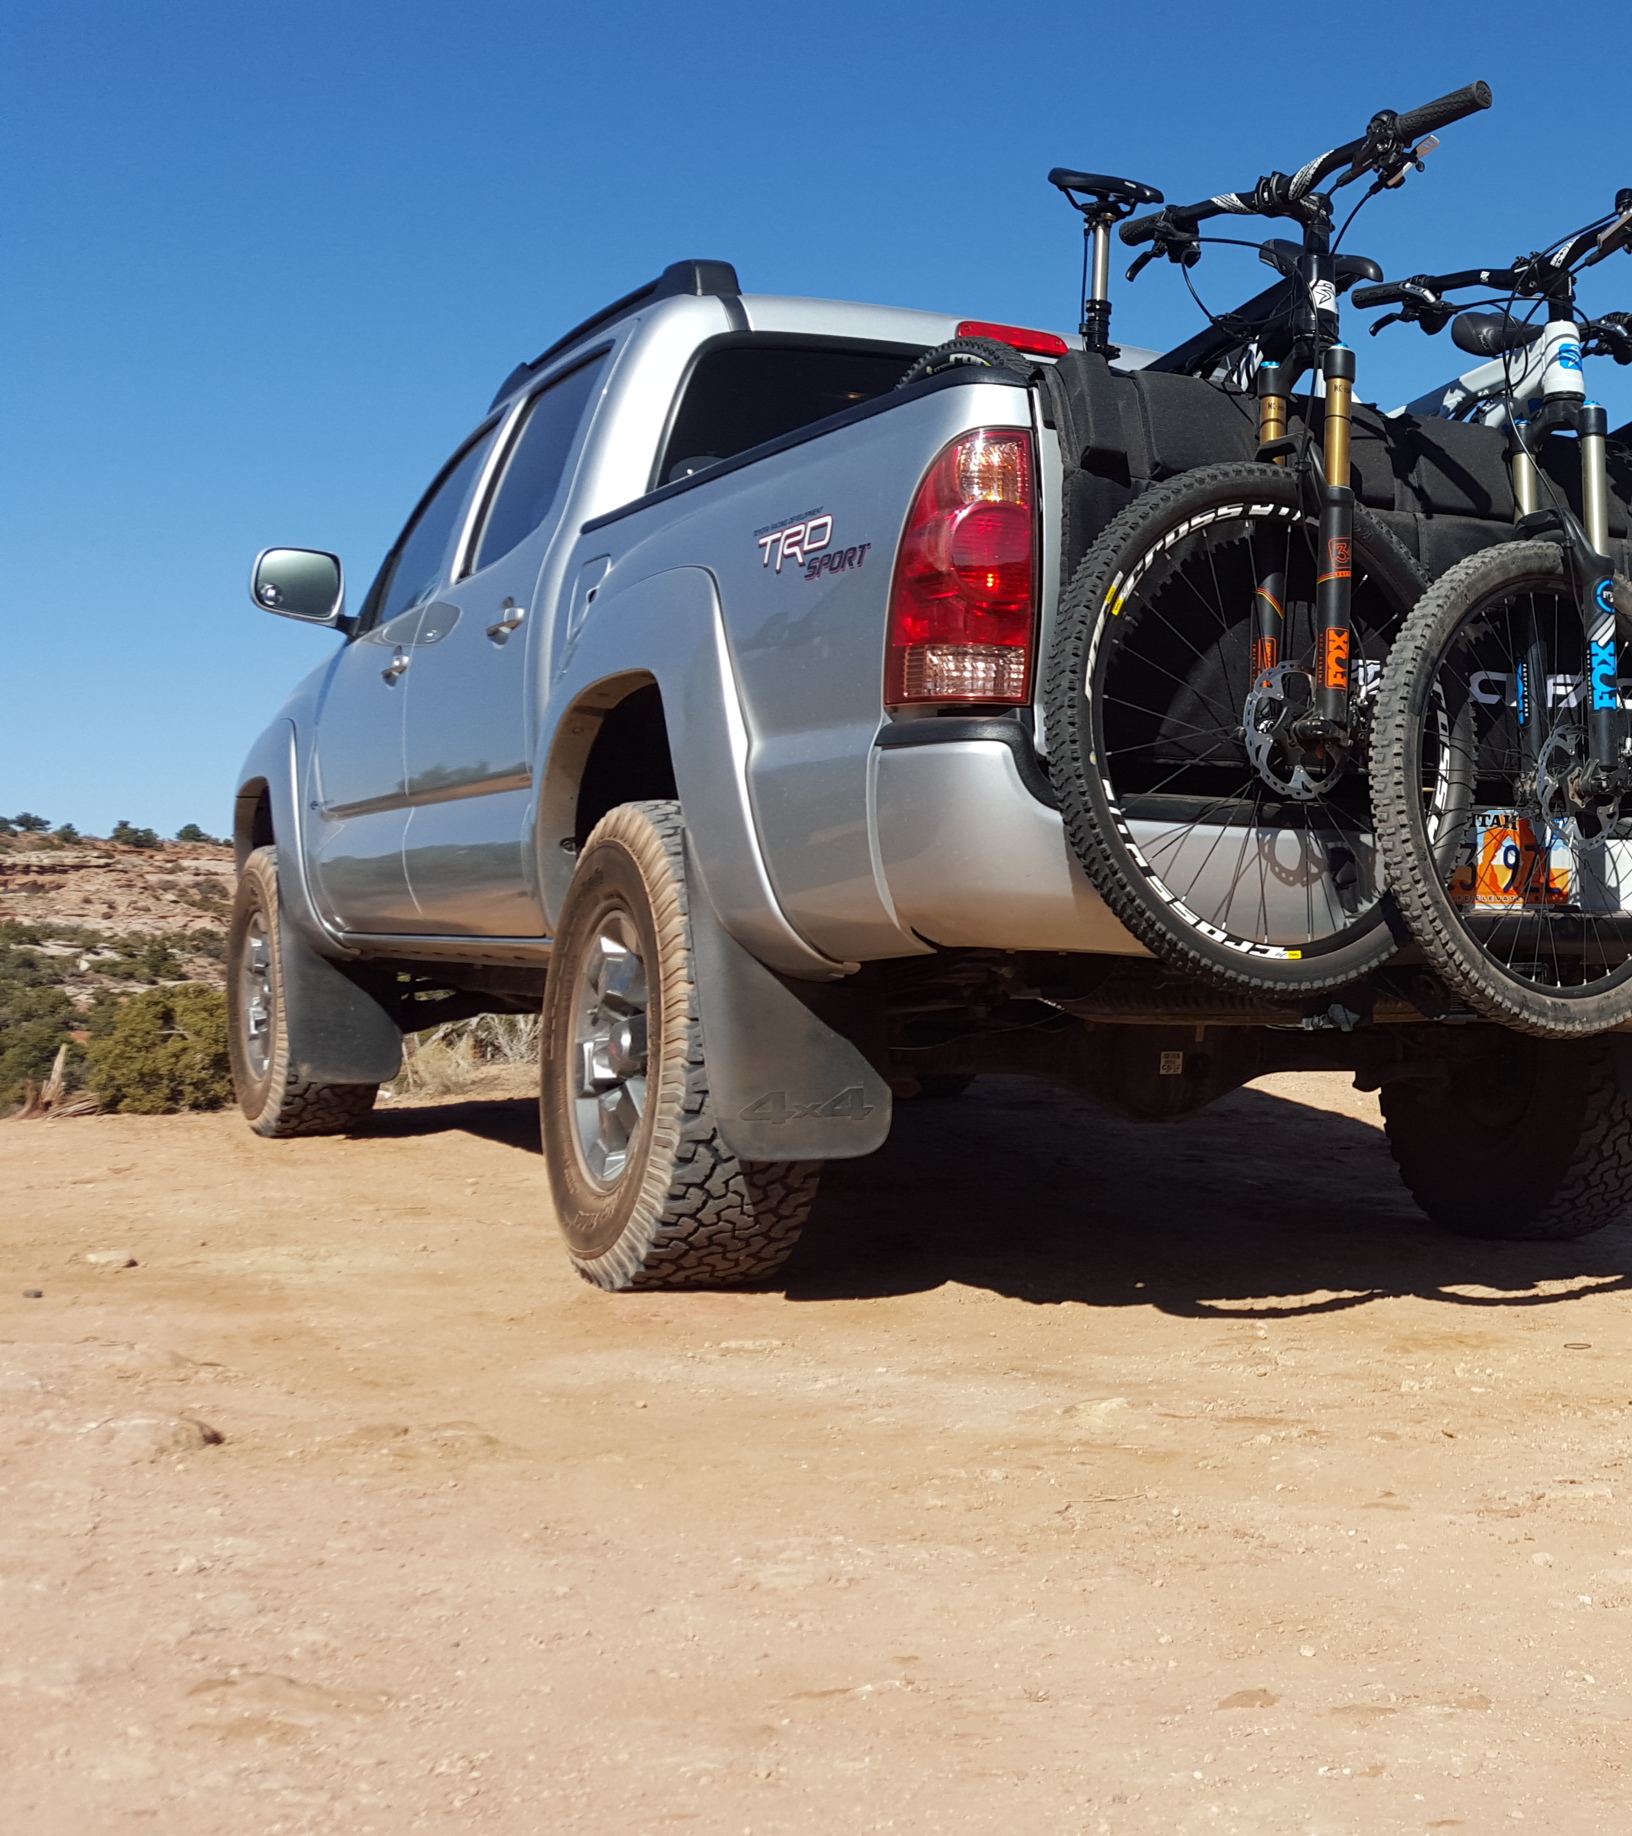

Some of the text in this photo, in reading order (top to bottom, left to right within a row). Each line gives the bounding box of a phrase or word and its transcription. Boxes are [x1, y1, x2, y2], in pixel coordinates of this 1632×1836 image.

[759, 513, 835, 574] TRD
[804, 543, 872, 580] SPORT
[1327, 629, 1349, 688] FOX
[1590, 641, 1617, 711] FOX
[738, 1086, 873, 1124] 4x4
